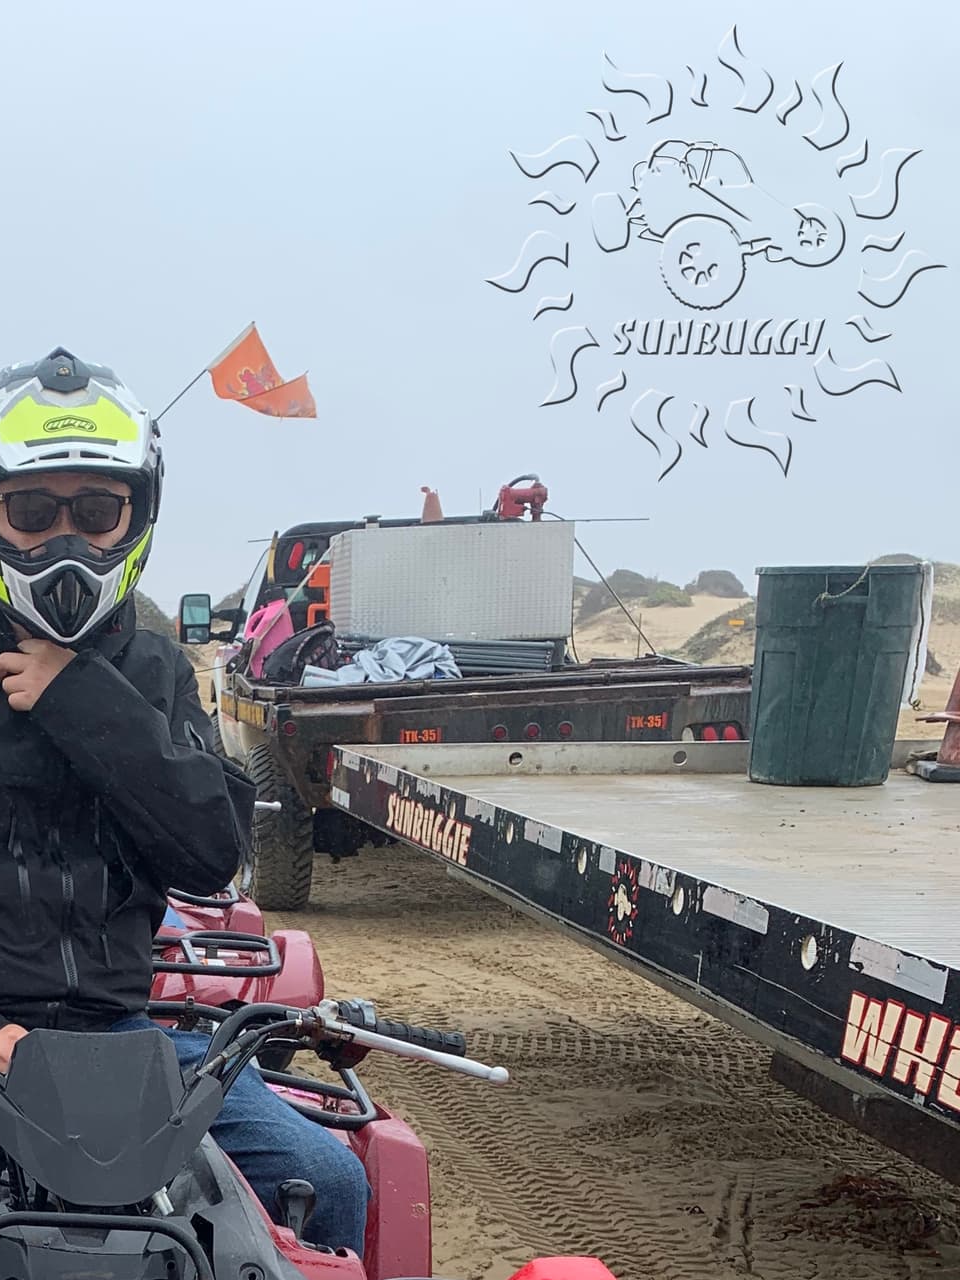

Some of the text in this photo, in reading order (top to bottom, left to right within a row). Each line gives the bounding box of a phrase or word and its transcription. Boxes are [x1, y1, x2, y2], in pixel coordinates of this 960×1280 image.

[630, 714, 663, 729] TK-35
[403, 728, 438, 743] TK-35
[386, 791, 472, 866] SUNBUGGIE
